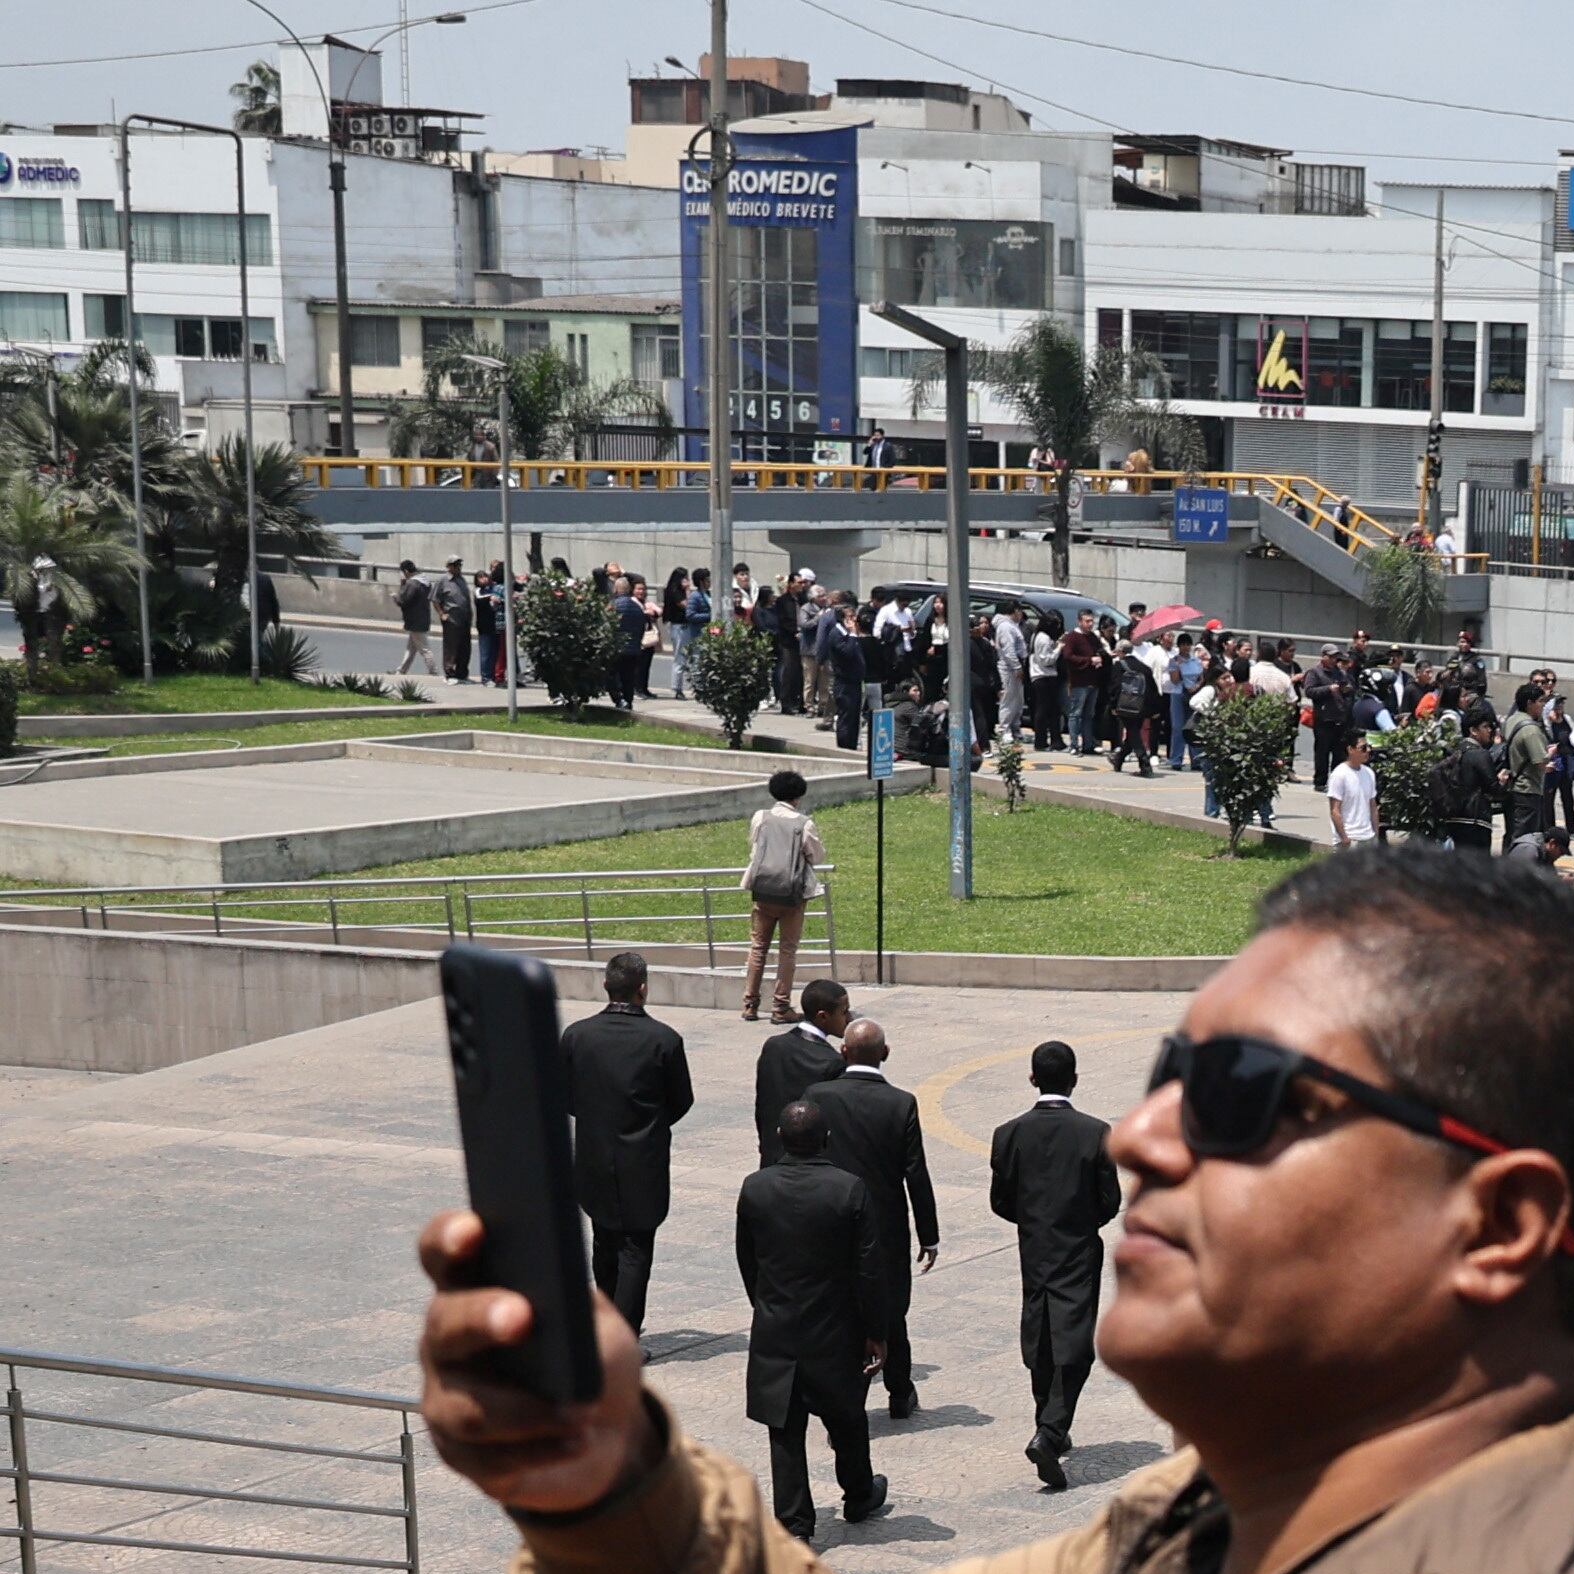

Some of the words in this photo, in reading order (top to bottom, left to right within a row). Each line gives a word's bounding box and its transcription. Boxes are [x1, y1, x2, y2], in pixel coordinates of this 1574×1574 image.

[18, 167, 79, 181] ADMEDIC
[727, 198, 771, 217] MÉDICO
[776, 203, 835, 219] BREVETE
